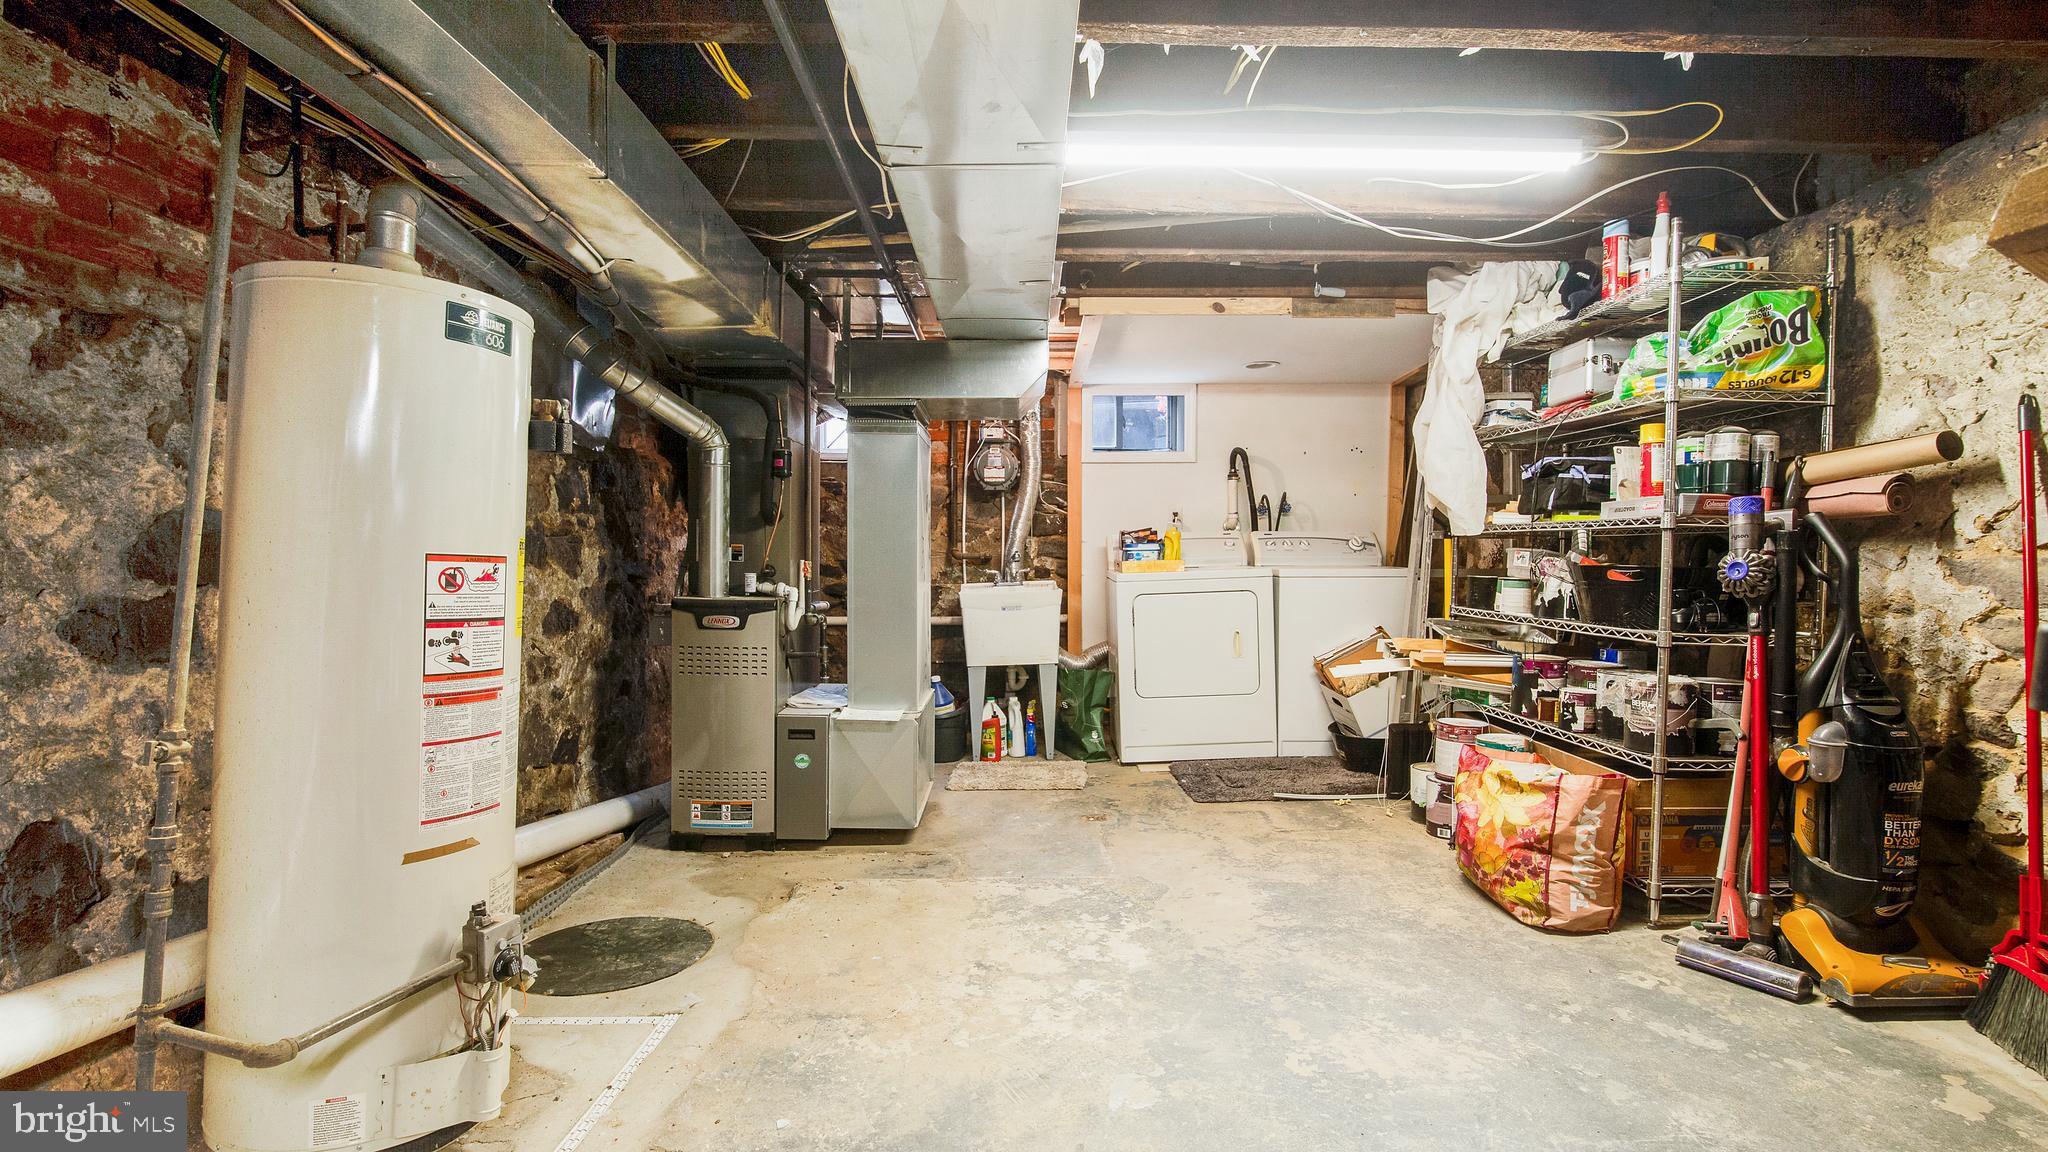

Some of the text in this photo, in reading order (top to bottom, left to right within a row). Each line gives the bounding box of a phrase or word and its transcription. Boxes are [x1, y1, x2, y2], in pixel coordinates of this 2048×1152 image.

[707, 617, 731, 625] LENNOX
[1888, 779, 1923, 792] eureka
[1884, 820, 1922, 830] BETTER
[1884, 829, 1915, 838] THAN
[1884, 836, 1921, 846] DYSON
